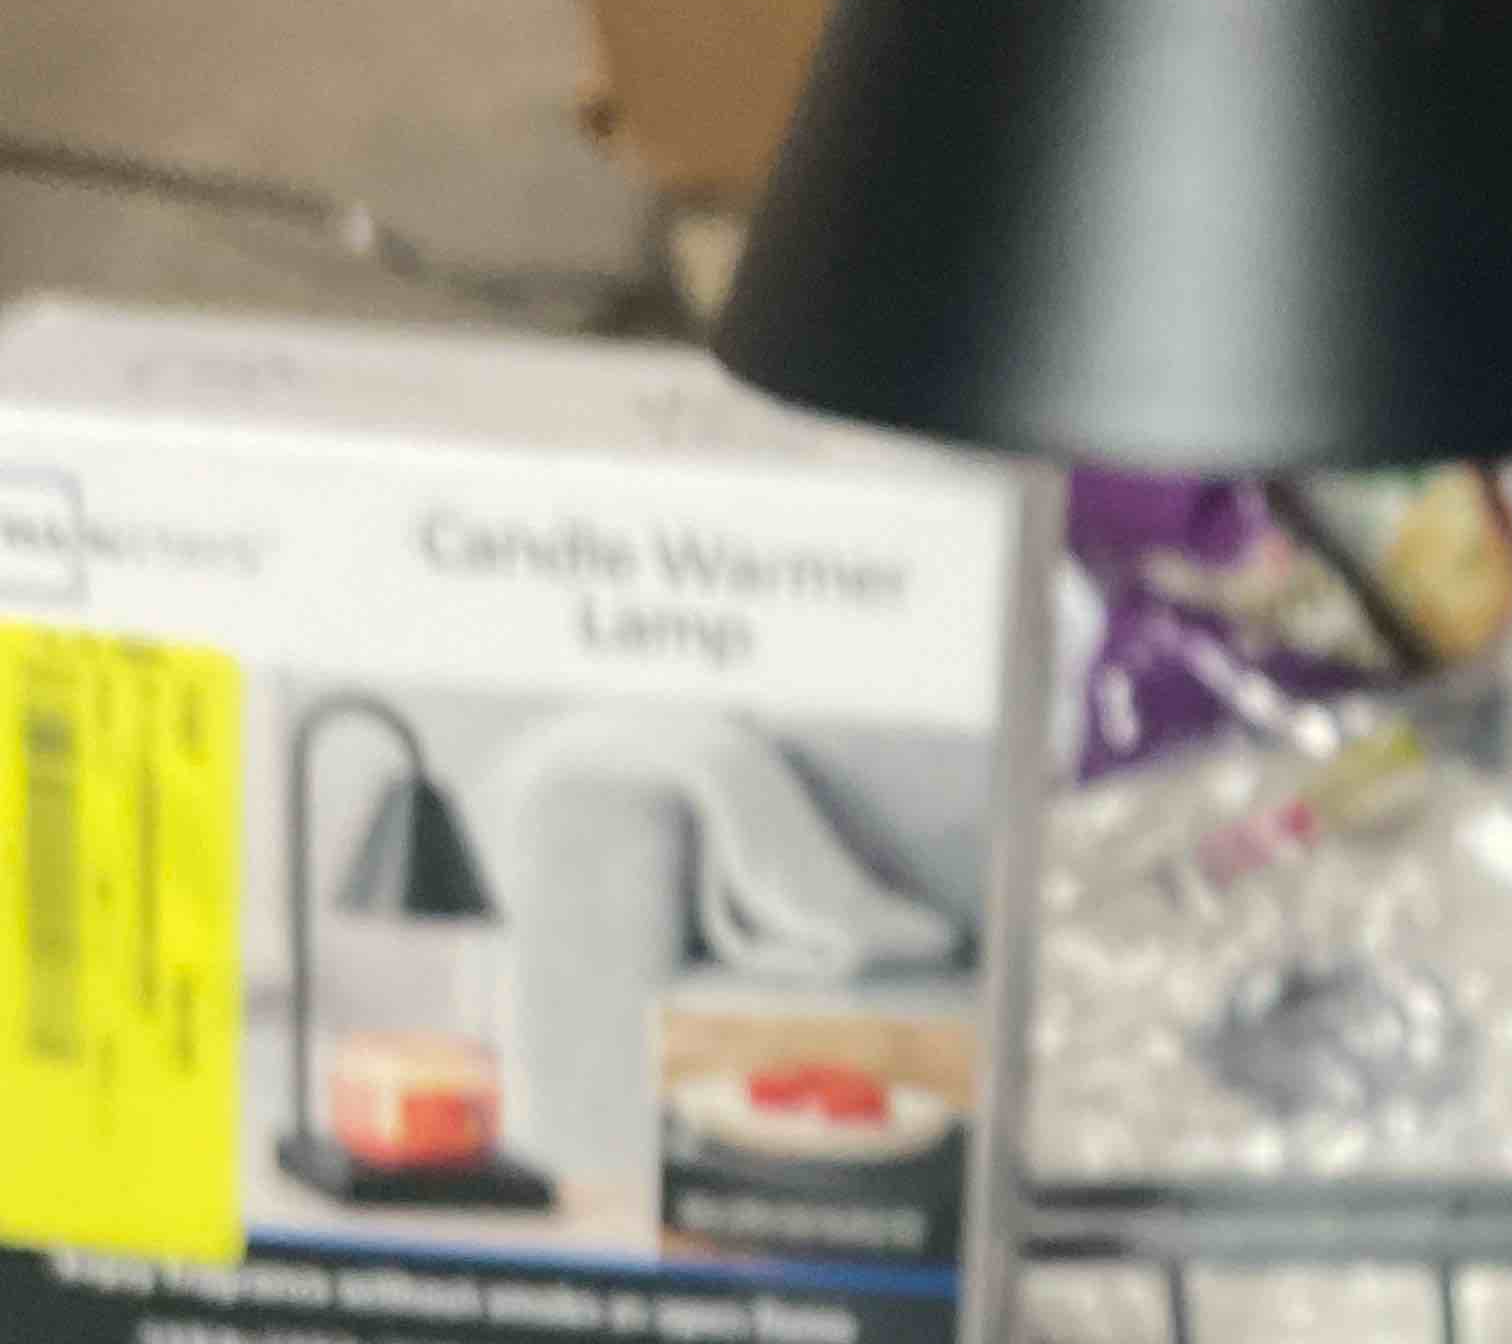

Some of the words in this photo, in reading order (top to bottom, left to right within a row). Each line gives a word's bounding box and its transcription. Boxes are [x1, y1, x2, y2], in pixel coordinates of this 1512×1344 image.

[413, 502, 638, 586] Candle
[648, 516, 910, 611] Warmer
[576, 592, 757, 670] Lamp
